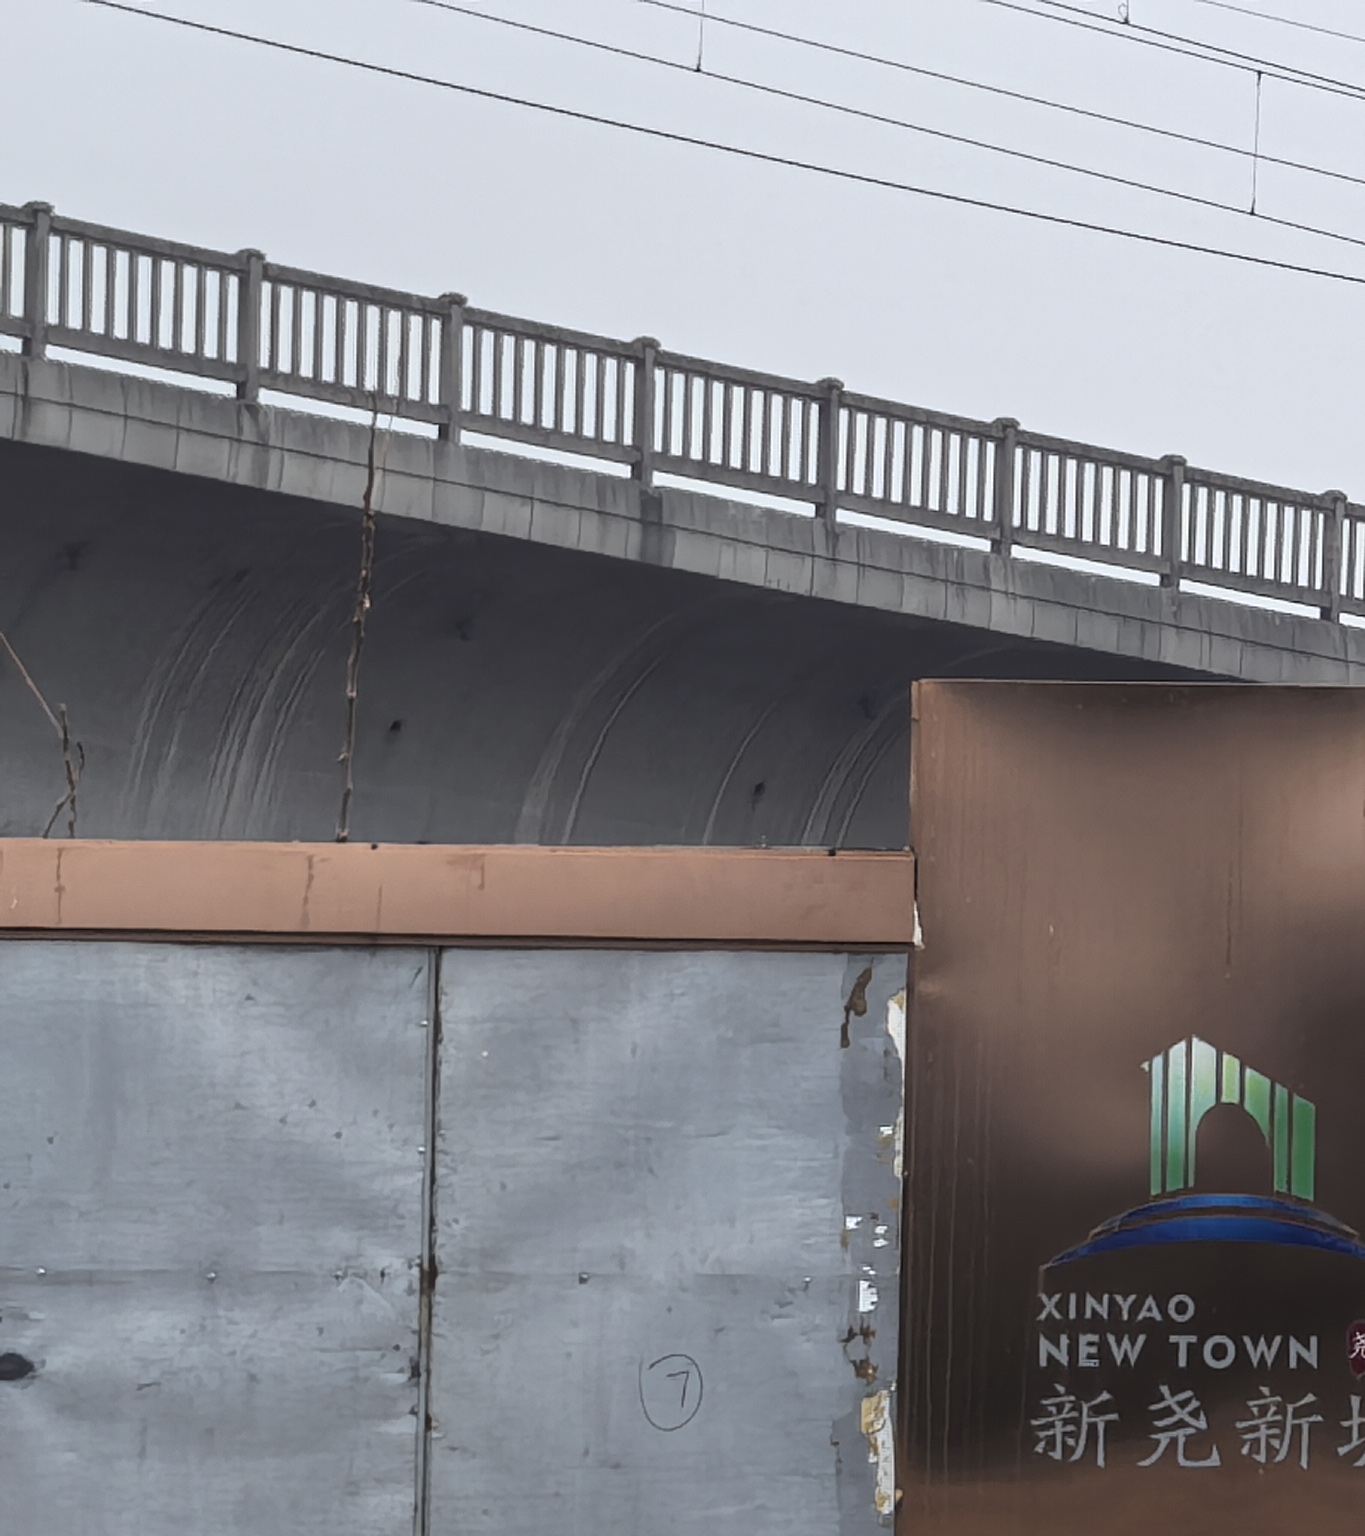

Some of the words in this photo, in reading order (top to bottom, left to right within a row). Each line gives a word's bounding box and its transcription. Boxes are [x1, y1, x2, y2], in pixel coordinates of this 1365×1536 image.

[1037, 1294, 1195, 1322] XINYAO
[1039, 1335, 1147, 1368] NEW
[1169, 1335, 1318, 1369] TOWN
